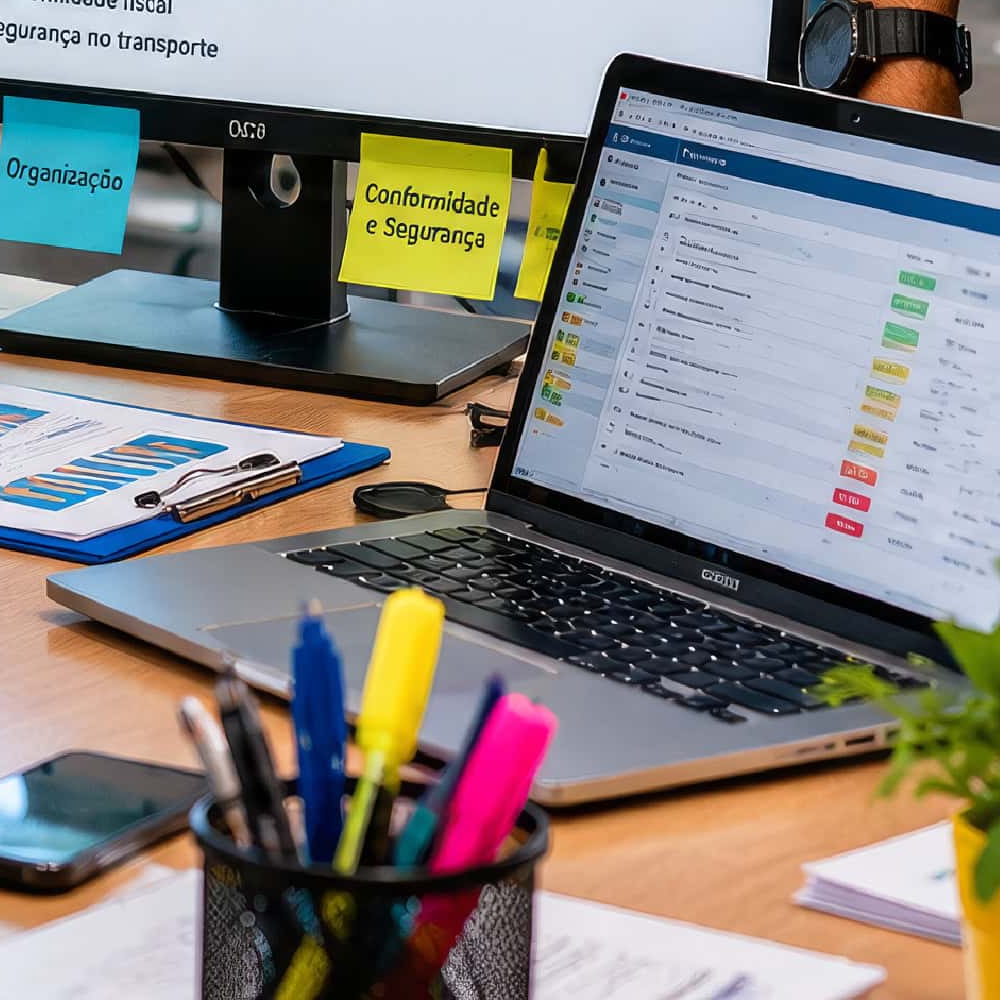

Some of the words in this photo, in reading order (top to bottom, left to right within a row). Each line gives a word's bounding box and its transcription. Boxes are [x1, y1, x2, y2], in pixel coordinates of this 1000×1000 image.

[87, 31, 111, 48] no
[117, 30, 219, 58] transporte
[365, 183, 500, 217] Conformidade
[366, 219, 377, 235] e
[383, 217, 486, 252] Segurança
